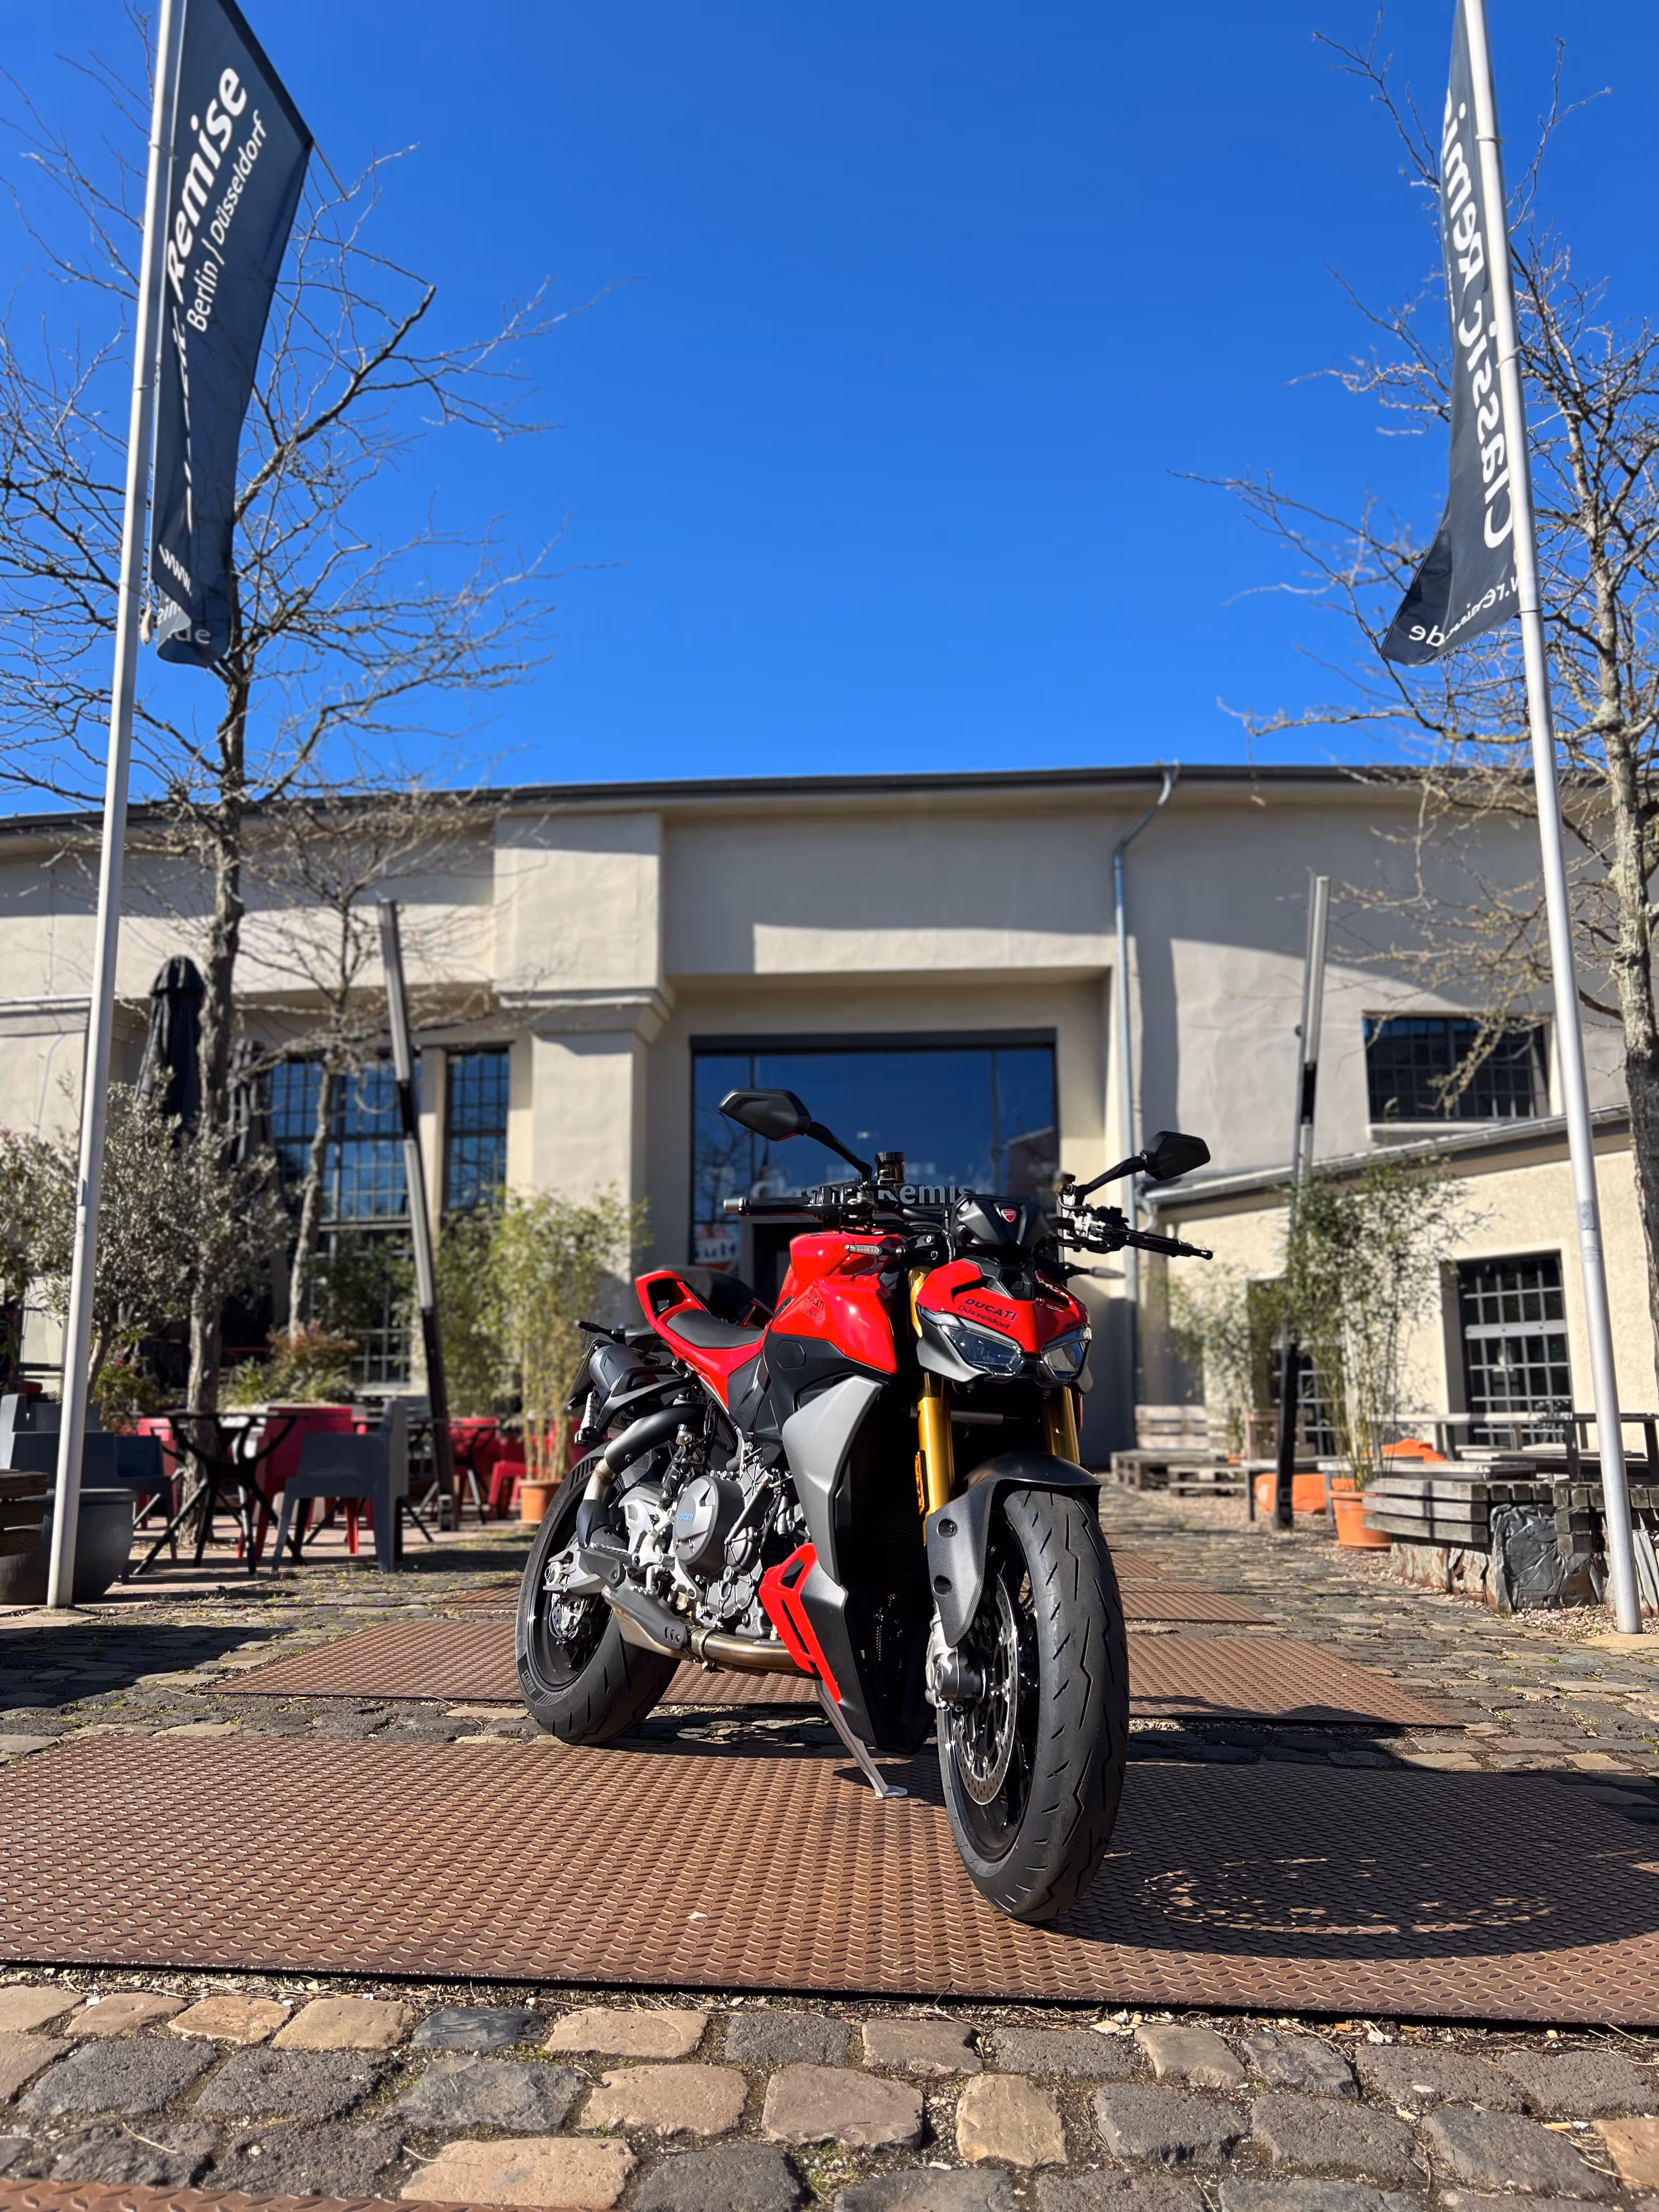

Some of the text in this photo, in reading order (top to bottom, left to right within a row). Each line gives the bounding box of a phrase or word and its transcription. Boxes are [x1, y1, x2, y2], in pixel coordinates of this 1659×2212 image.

[168, 67, 247, 304] Remise
[187, 261, 218, 332] Berlin
[210, 109, 267, 245] Düsseldorf
[964, 1298, 1017, 1321] DUCATI
[676, 1513, 694, 1521] DUCATI
[521, 1669, 537, 1695] PIRELLI
